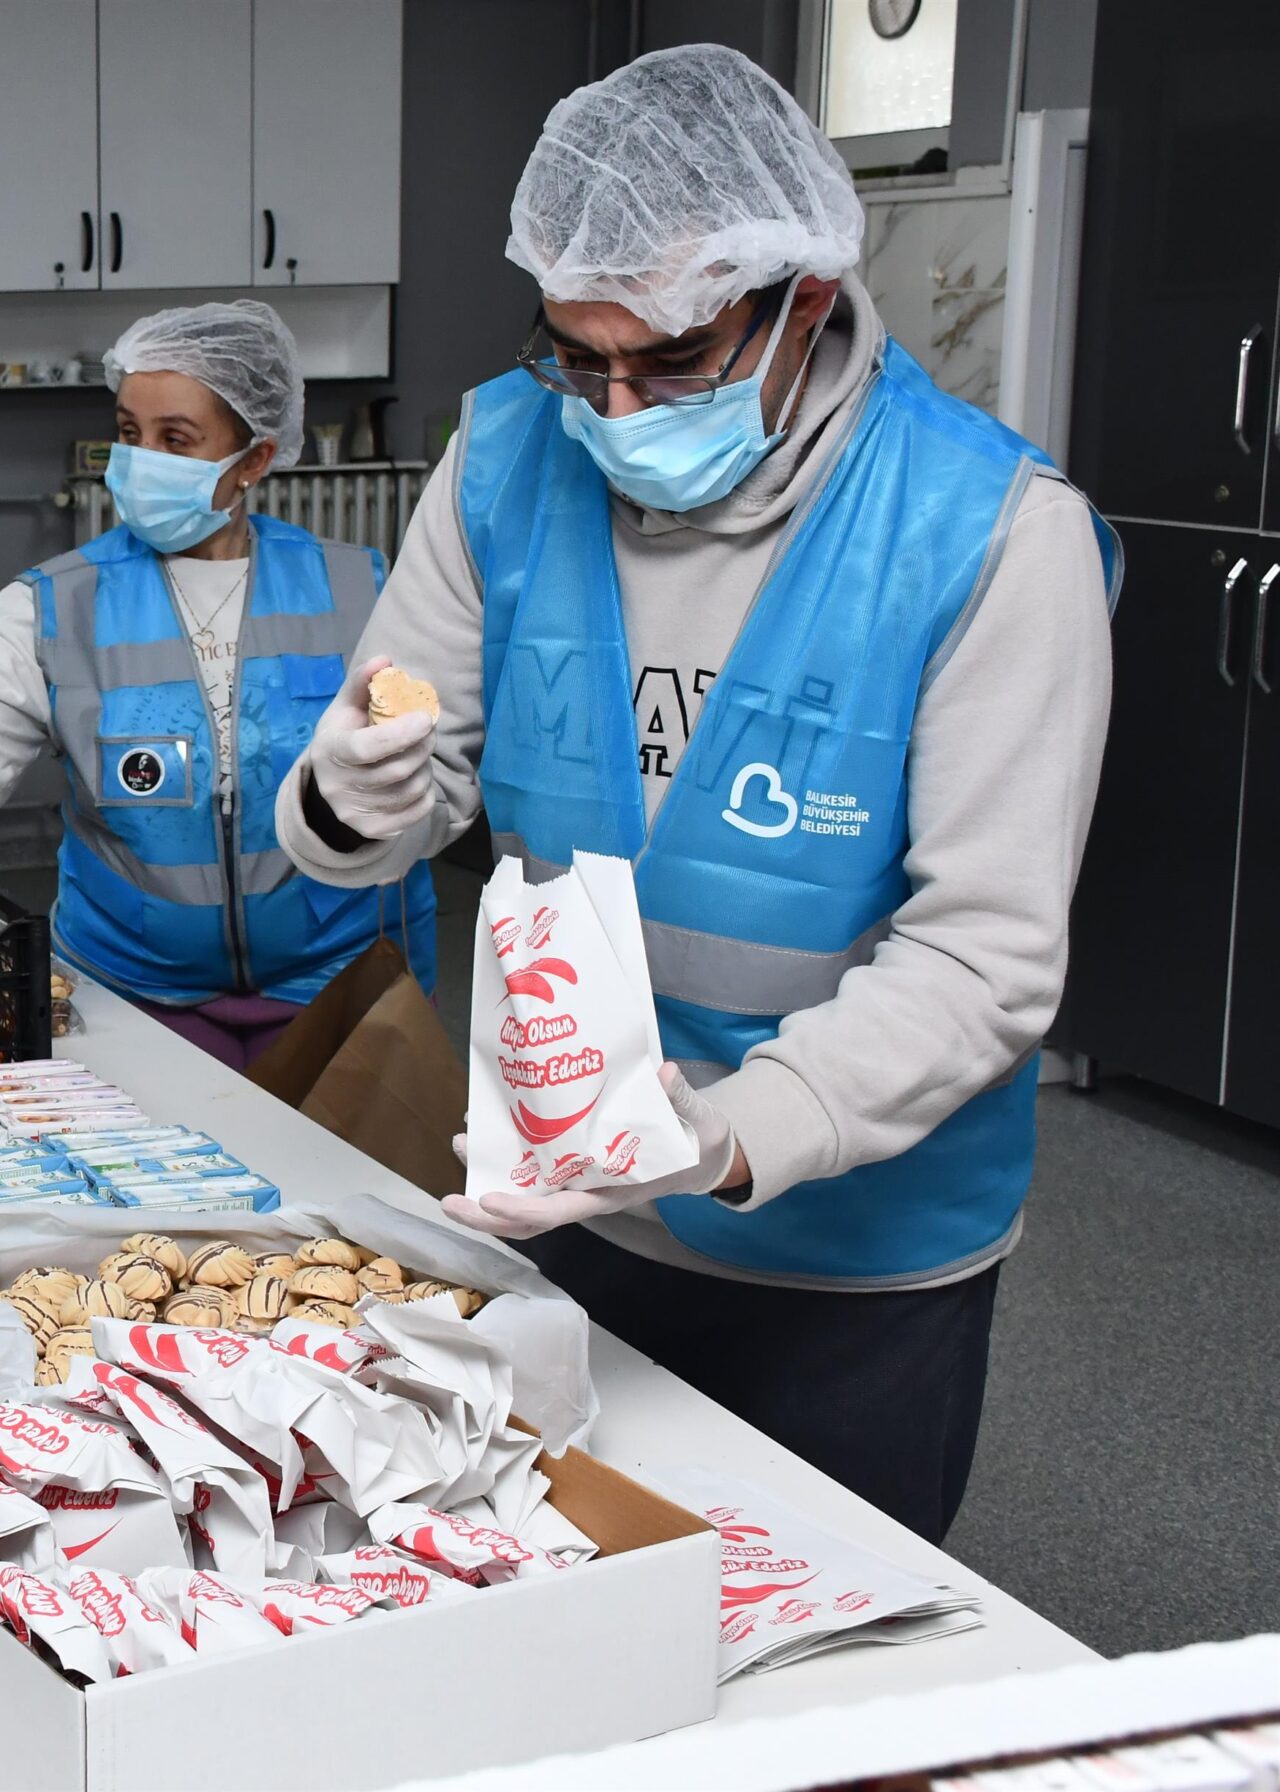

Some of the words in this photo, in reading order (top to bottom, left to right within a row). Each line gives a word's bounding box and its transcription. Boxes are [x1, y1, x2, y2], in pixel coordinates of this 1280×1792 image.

[806, 790, 857, 808] BALIKESİR
[803, 804, 870, 824] BÜYÜKŞEHİR
[800, 819, 861, 837] BELEDİYESİ
[526, 1015, 577, 1046] Olsun
[546, 1047, 603, 1086] Ederiz
[749, 1559, 808, 1573] Ederiz
